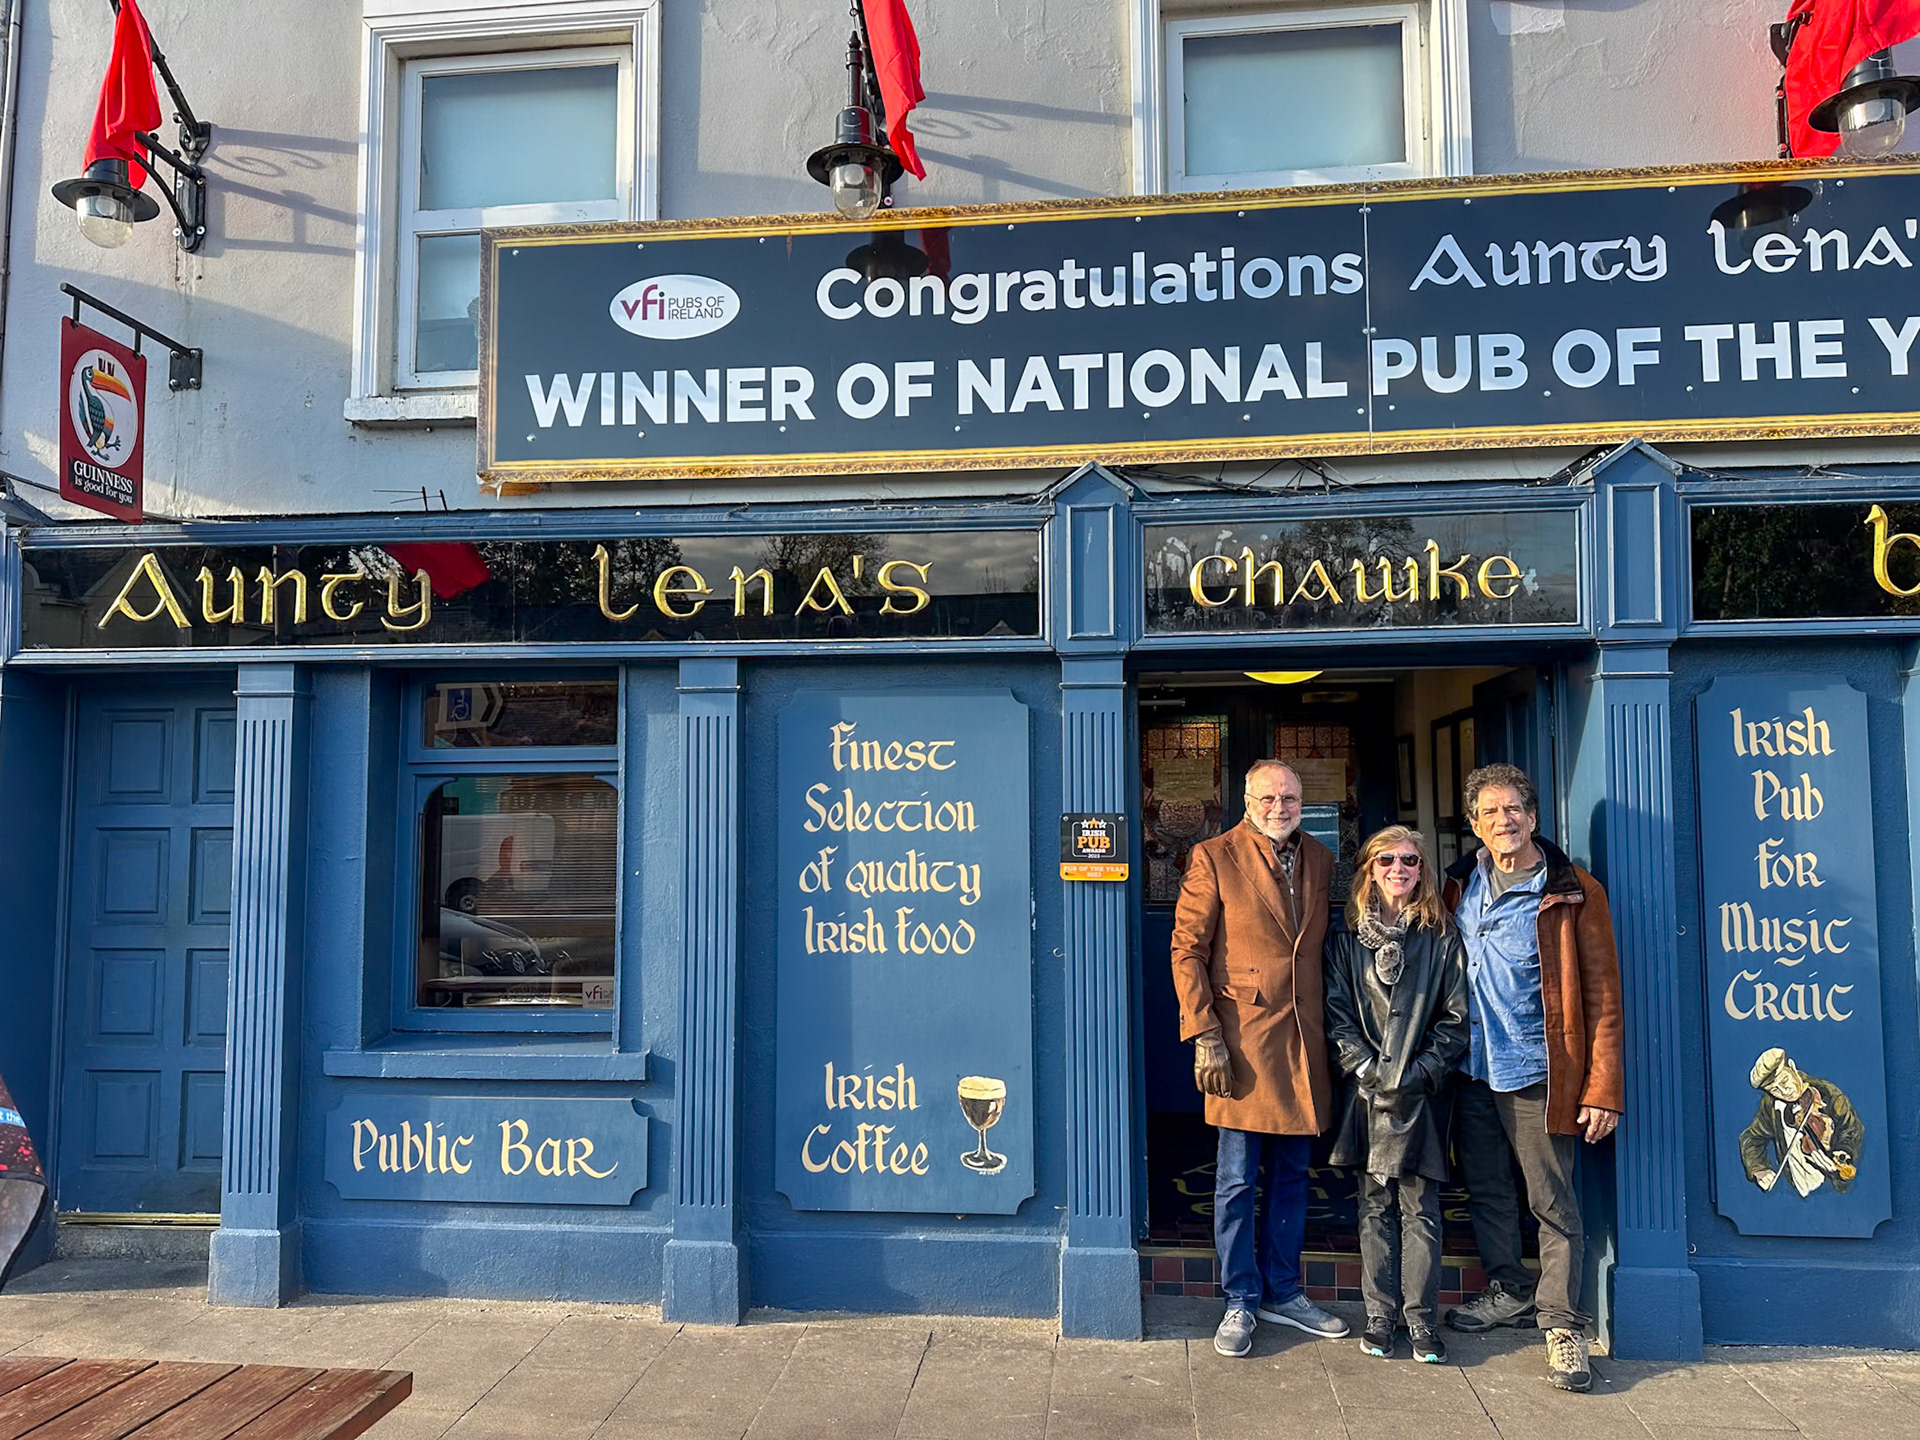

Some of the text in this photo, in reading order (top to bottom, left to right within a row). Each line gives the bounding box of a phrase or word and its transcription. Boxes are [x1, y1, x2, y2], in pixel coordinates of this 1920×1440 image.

[620, 284, 665, 320] vfi
[668, 296, 725, 309] PUBS OF
[816, 245, 1364, 325] Congratulations
[1409, 234, 1668, 291] Aunty
[668, 307, 724, 320] IRELAND
[525, 366, 815, 428] WINNER
[837, 361, 935, 420] OF
[957, 342, 1348, 416] NATIONAL
[1372, 333, 1528, 396] PUB
[1552, 326, 1662, 389] OF
[1684, 319, 1848, 383] THE
[73, 460, 133, 494] GUINNESS
[84, 480, 104, 493] good
[105, 485, 117, 499] for
[118, 491, 133, 504] you
[98, 552, 433, 631] Aunty
[1729, 706, 1836, 757] Irish
[803, 782, 980, 833] Selection
[1752, 769, 1824, 821] Pub
[1077, 836, 1110, 848] PUB
[799, 846, 838, 893] of
[802, 905, 888, 954] Irish
[1718, 901, 1852, 966] Music
[1724, 969, 1854, 1022] Craic
[824, 1061, 919, 1112] Irish
[6, 1112, 21, 1123] the
[351, 1118, 619, 1179] Public Bar
[801, 1121, 930, 1176] Coffee
